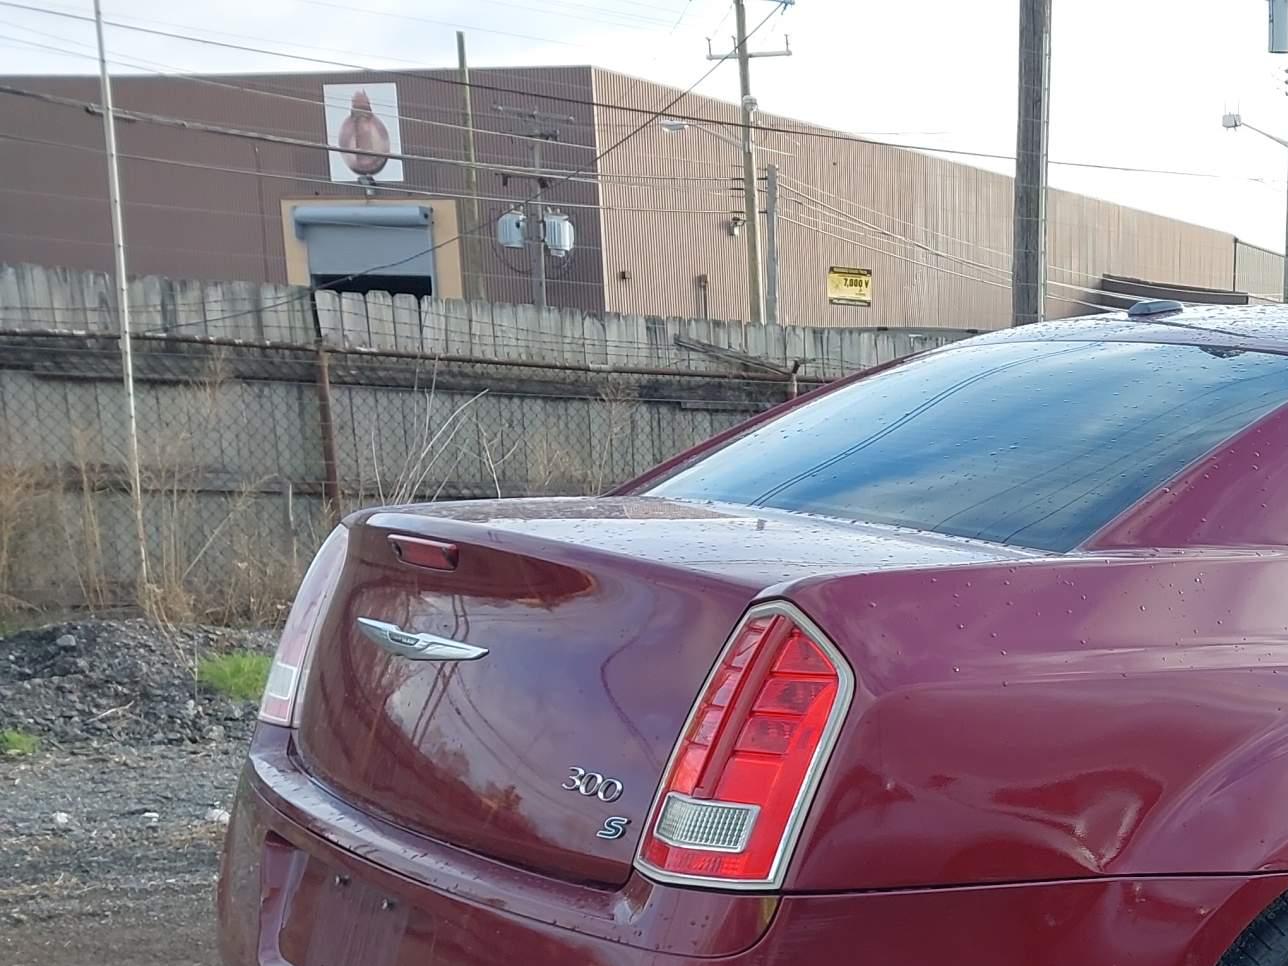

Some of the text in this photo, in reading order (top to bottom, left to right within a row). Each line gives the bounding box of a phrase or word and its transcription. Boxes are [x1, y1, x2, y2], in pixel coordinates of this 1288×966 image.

[844, 278, 862, 288] 7,000
[561, 766, 623, 802] 300
[596, 816, 629, 839] S
